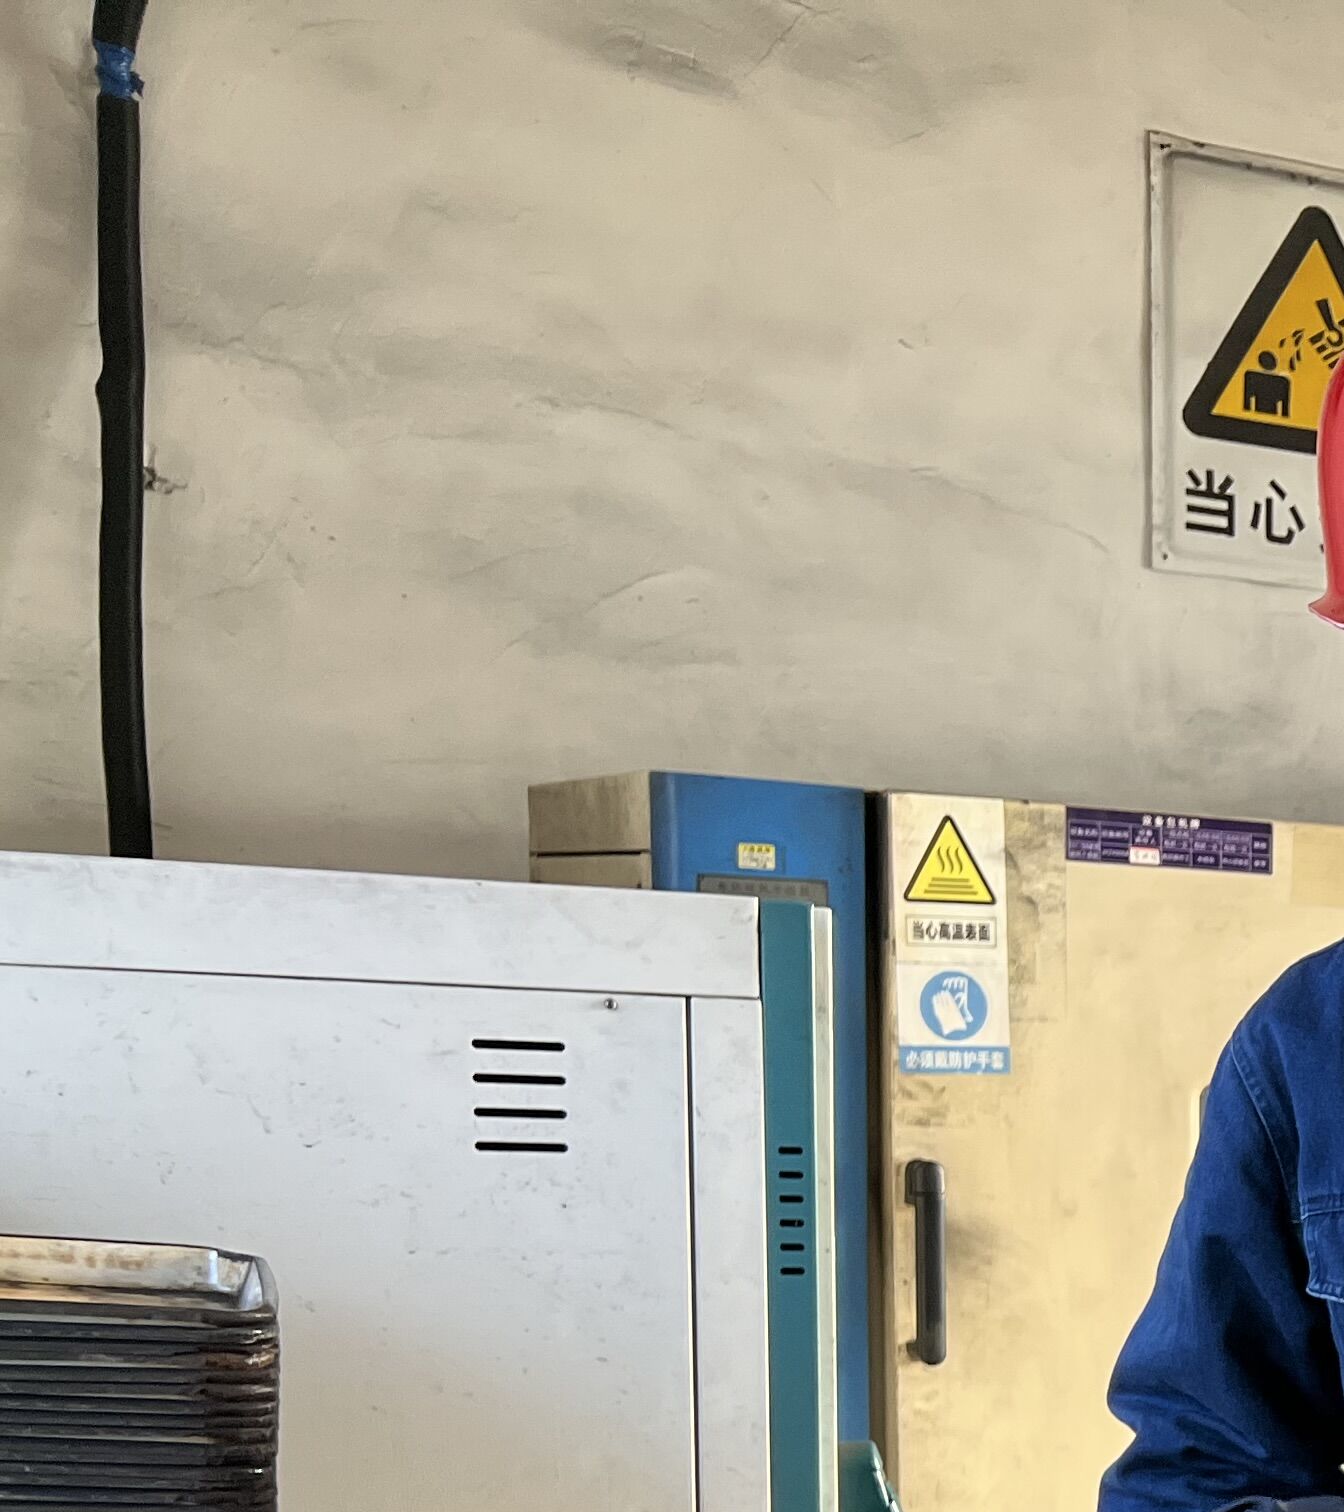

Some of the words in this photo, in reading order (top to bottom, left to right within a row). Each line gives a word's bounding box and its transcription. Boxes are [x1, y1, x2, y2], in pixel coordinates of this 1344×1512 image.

[1185, 469, 1325, 553] 当心
[912, 920, 991, 942] 当心高温表面
